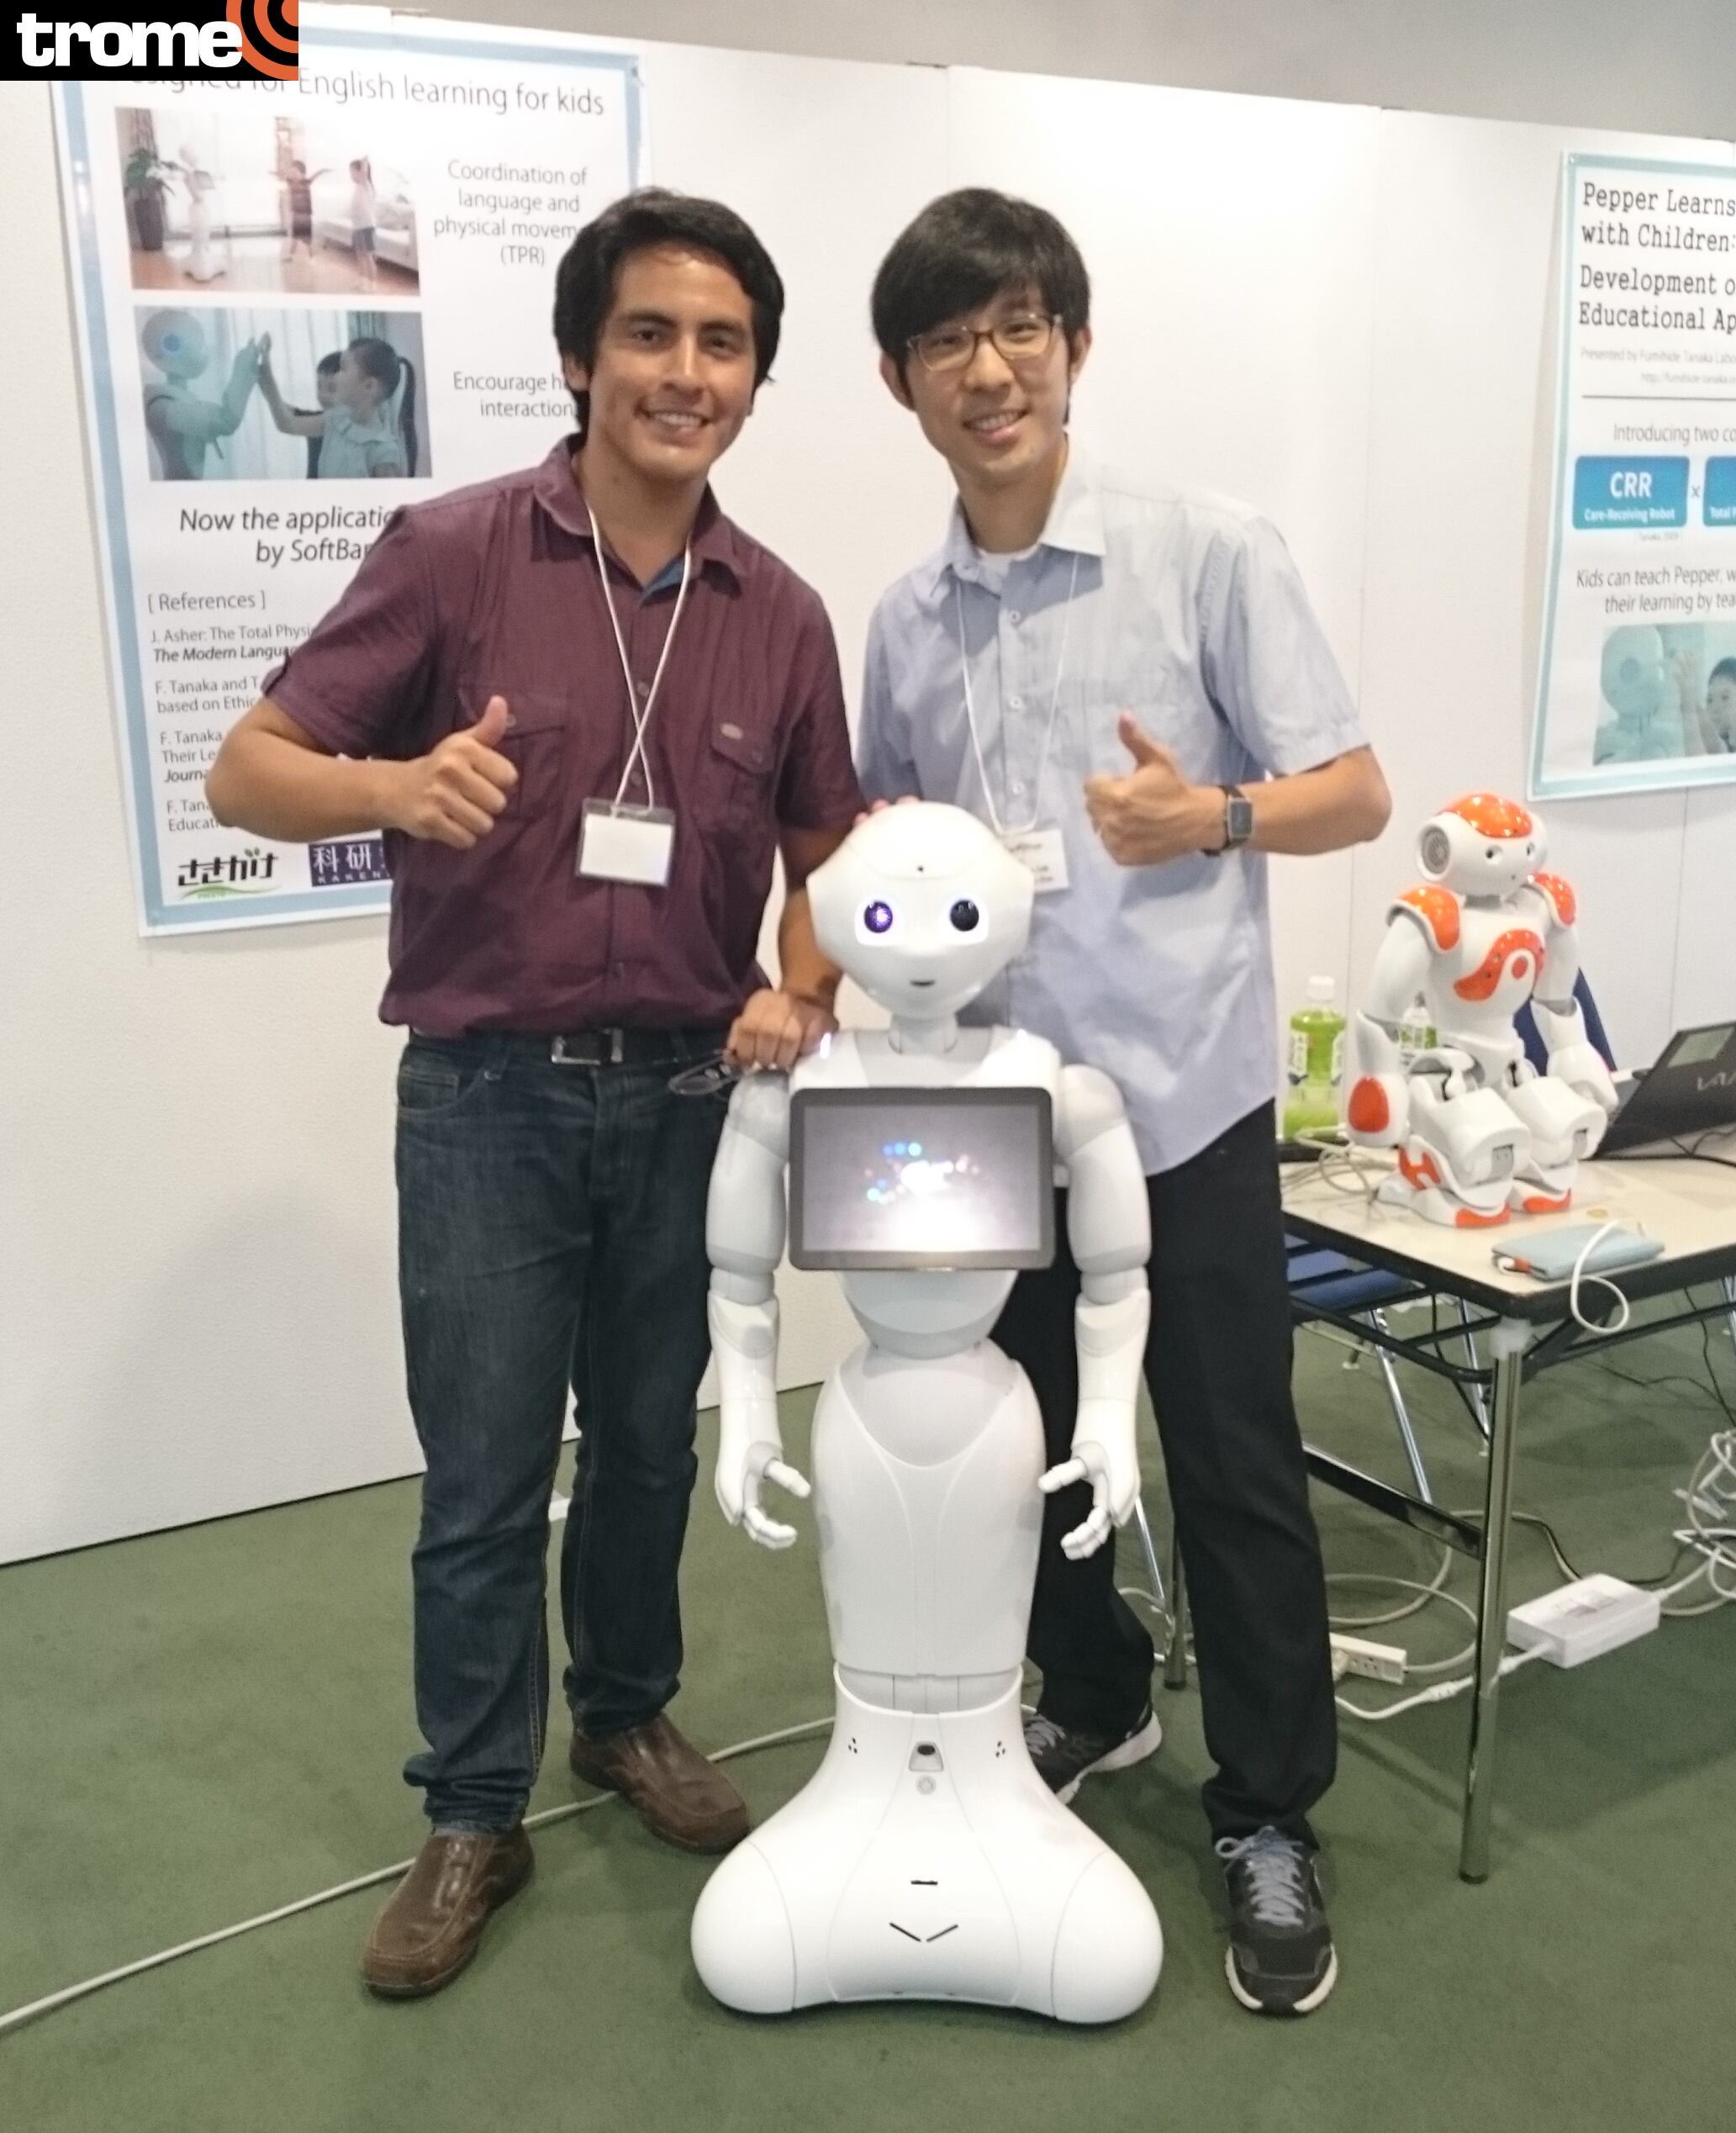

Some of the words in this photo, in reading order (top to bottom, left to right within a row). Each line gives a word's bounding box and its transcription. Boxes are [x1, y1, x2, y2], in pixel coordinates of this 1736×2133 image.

[298, 67, 393, 104] English
[404, 74, 506, 115] learning
[517, 82, 549, 110] for
[557, 86, 604, 115] kids
[447, 159, 564, 184] Coordination
[570, 166, 588, 186] of
[459, 187, 542, 215] language
[547, 194, 579, 212] and
[1582, 181, 1659, 213] Pepper
[1666, 188, 1736, 217] Learns
[434, 215, 504, 240] physical
[1581, 220, 1629, 246] with
[1638, 223, 1736, 252] Children:
[500, 244, 545, 267] (TPR)
[1580, 264, 1717, 296] Development
[1579, 301, 1705, 330] Educational
[453, 371, 546, 395] Encourage
[480, 399, 573, 418] interaction
[1613, 424, 1690, 447] Introducing
[1694, 425, 1718, 442] two
[1610, 471, 1653, 499] CRR
[180, 507, 234, 531] Now
[241, 505, 279, 531] the
[256, 539, 284, 568] by
[1577, 569, 1603, 588] Kids
[1607, 571, 1630, 586] can
[1634, 566, 1670, 586] teach
[159, 591, 256, 611] References
[1605, 594, 1635, 614] their
[1639, 593, 1693, 615] learning
[1696, 591, 1712, 613] by
[211, 626, 235, 641] The
[240, 625, 271, 639] Total
[154, 647, 179, 663] The
[182, 646, 236, 662] Modern
[156, 680, 166, 694] F.
[171, 678, 218, 694] Tanaka
[222, 676, 247, 690] and
[157, 700, 198, 714] based
[203, 699, 219, 710] on
[160, 731, 171, 745] F.
[175, 730, 222, 744] Tanaka
[161, 749, 197, 763] Their
[166, 800, 177, 813] F.
[313, 842, 386, 874] 科研
[317, 869, 390, 884] KAKEN
